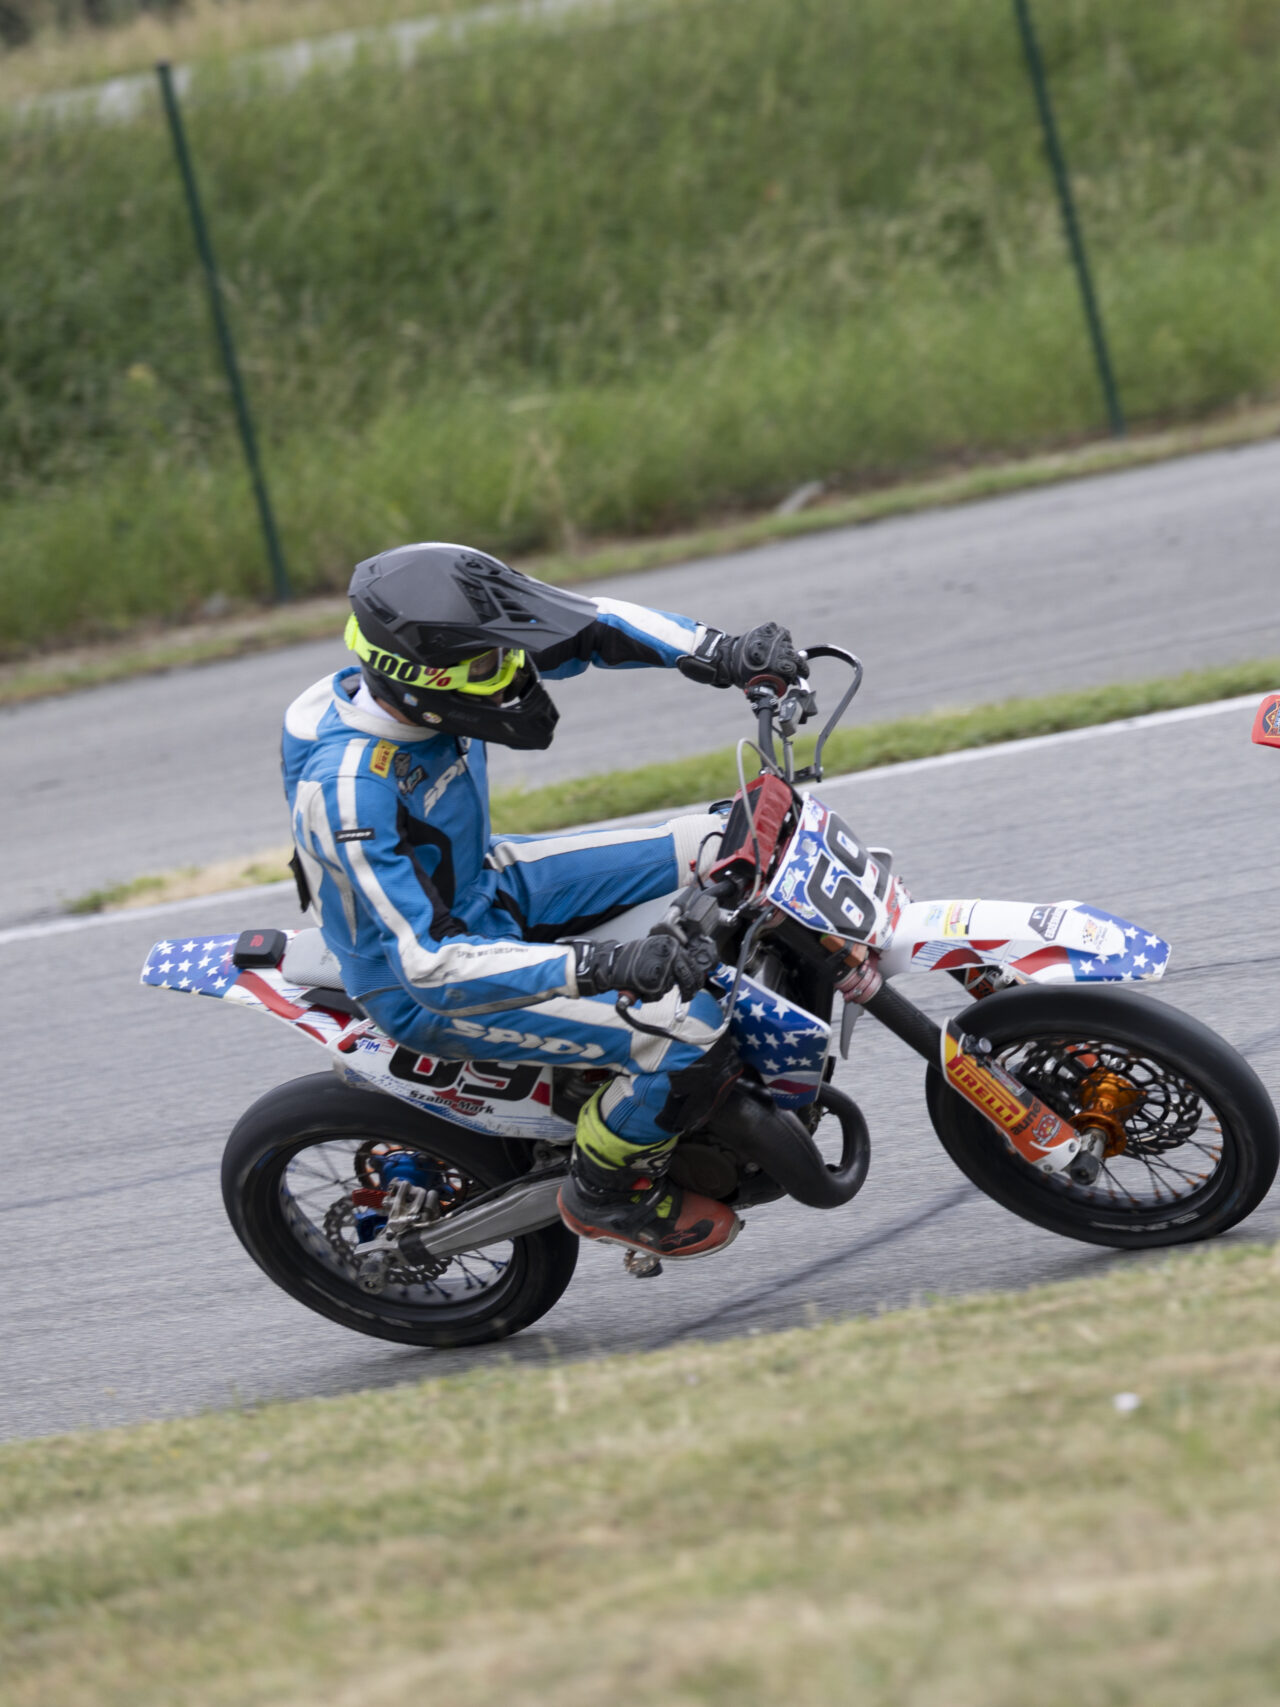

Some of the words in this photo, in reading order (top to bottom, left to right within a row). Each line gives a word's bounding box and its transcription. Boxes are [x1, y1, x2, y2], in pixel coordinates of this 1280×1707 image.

[367, 648, 452, 687] 100%
[806, 811, 890, 942] 69
[443, 1018, 606, 1060] SPIDI
[947, 1055, 1021, 1123] PIRELLI
